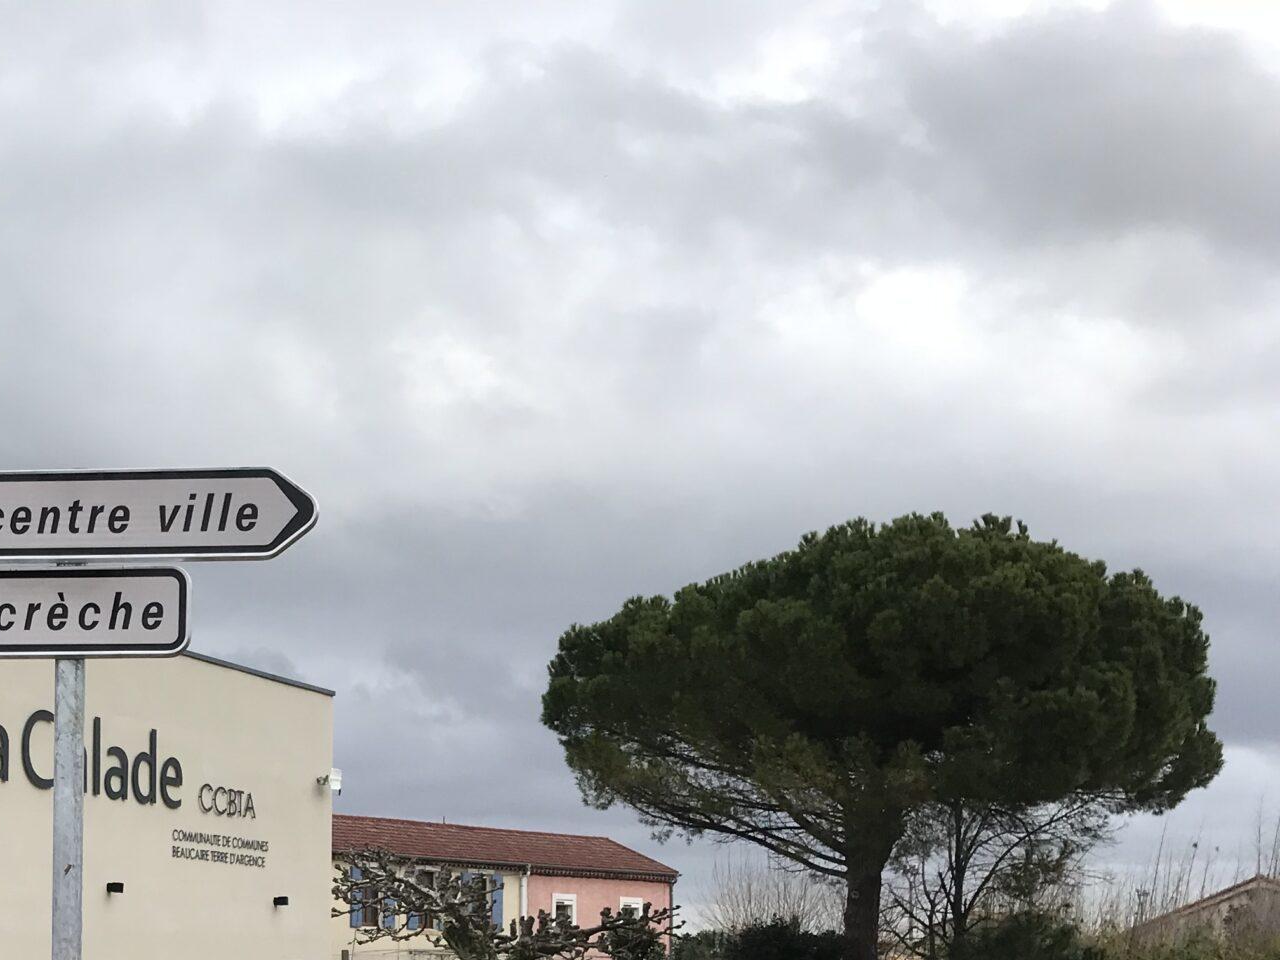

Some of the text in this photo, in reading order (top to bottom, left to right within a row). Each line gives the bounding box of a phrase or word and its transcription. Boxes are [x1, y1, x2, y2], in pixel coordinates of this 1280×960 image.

[158, 493, 260, 532] ville
[20, 709, 183, 809] Clade
[198, 783, 256, 820] CCBTA
[172, 845, 210, 861] BEAUCAIRE
[211, 850, 228, 864] TERRE
[222, 836, 231, 848] DE
[232, 837, 269, 852] COMMUNES
